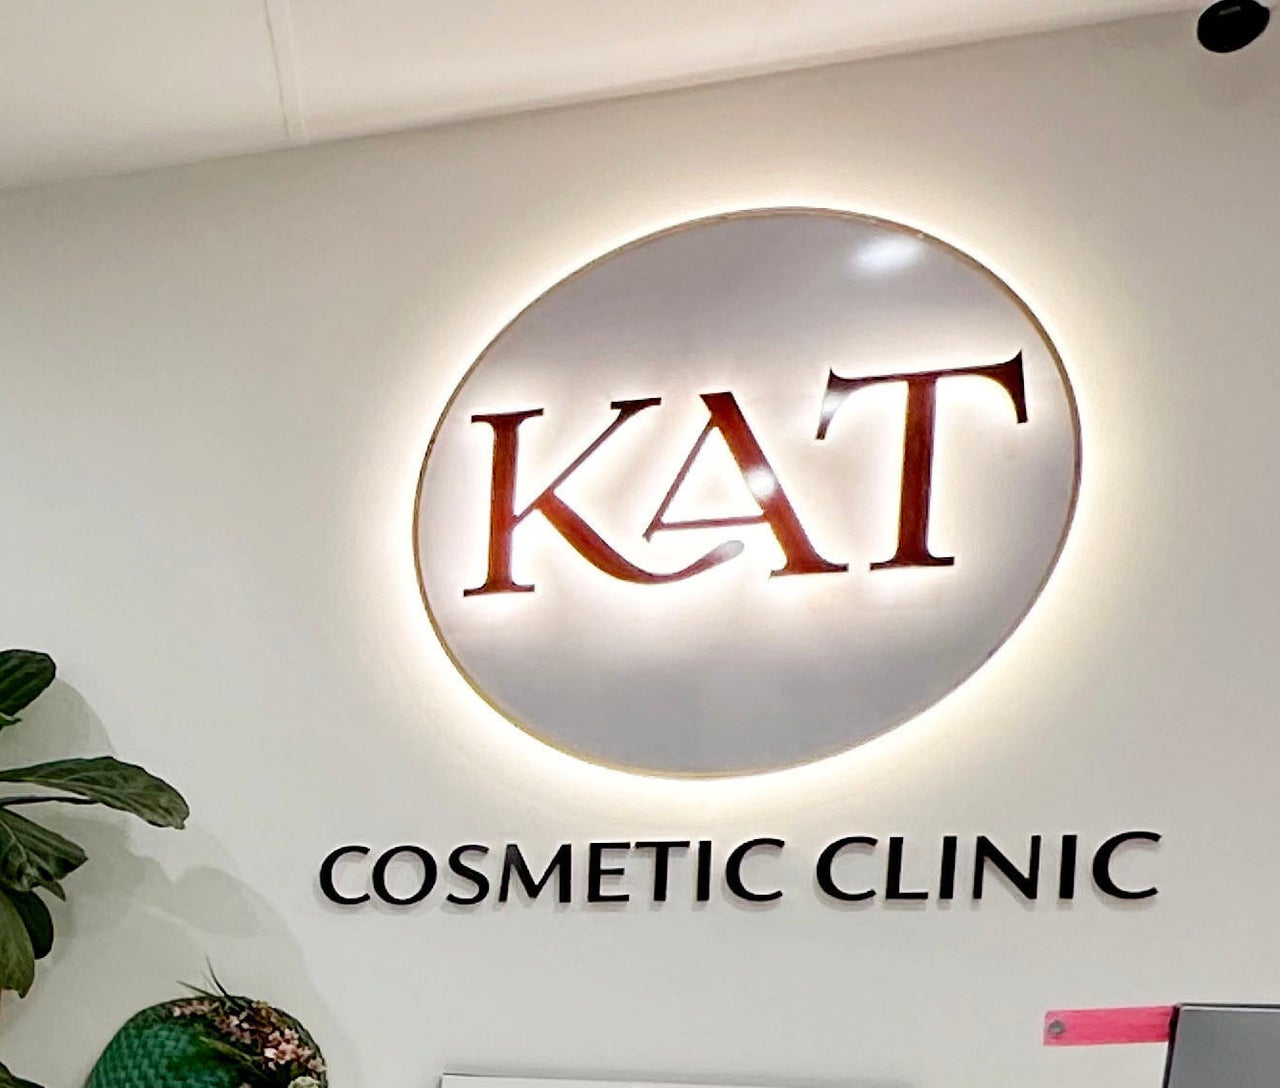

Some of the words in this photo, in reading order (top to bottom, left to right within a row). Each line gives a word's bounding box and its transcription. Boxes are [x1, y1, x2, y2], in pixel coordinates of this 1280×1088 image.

[462, 349, 1029, 599] KAT
[318, 837, 784, 906] COSMETIC
[815, 830, 1162, 902] CLINIC
